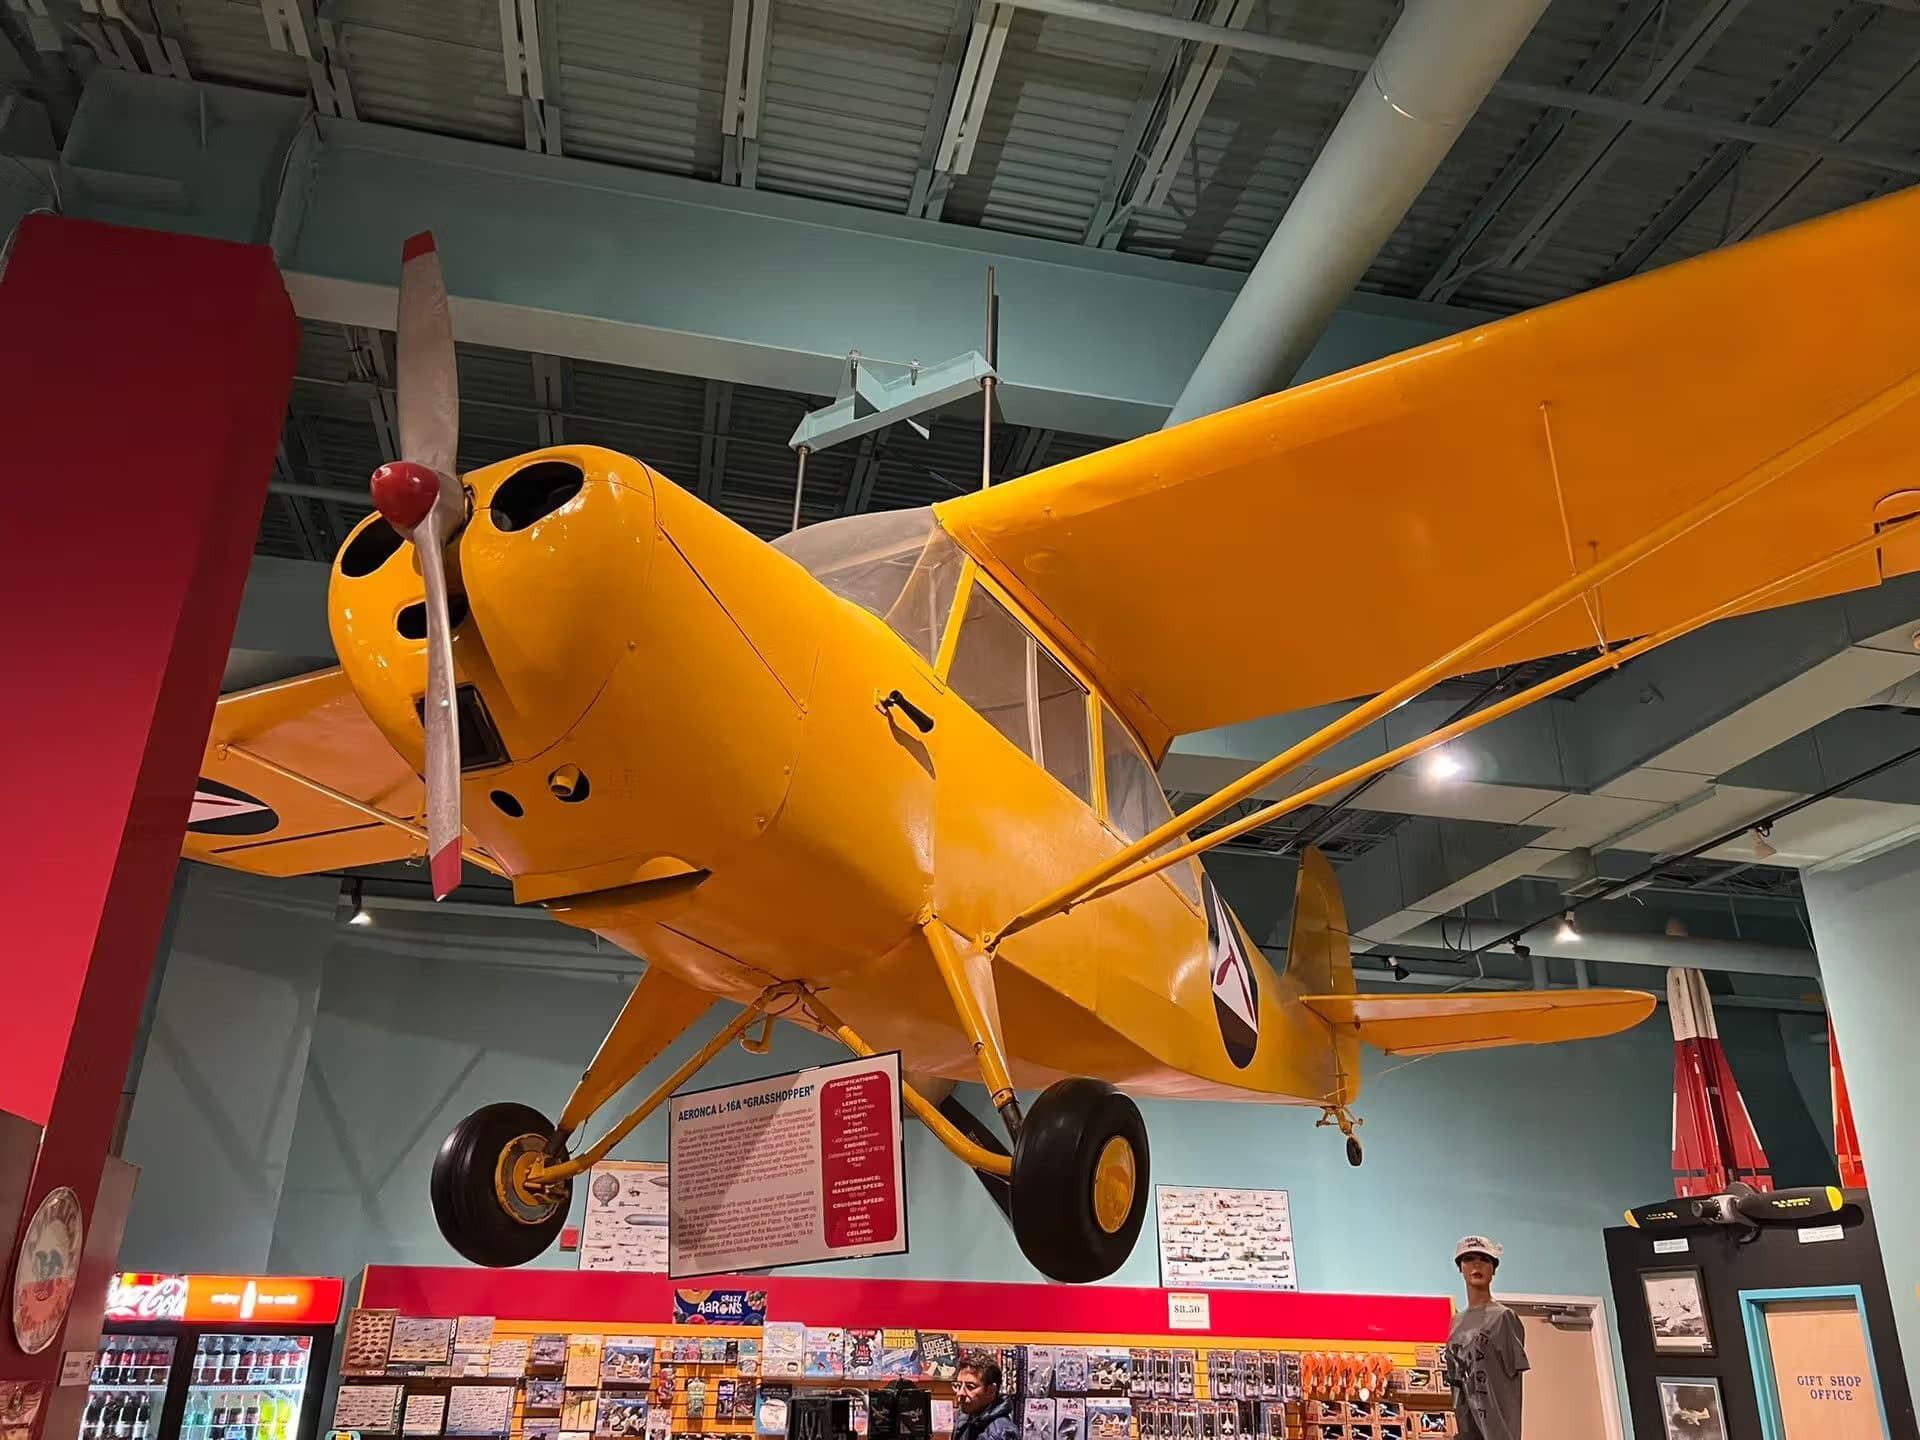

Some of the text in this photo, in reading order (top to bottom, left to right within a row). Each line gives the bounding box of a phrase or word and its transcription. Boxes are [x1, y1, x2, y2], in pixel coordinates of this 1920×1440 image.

[678, 1105, 716, 1122] AERONCA
[718, 1101, 742, 1114] L-16A
[1174, 1304, 1200, 1313] $8.50
[922, 1338, 946, 1350] DOGS
[924, 1346, 954, 1360] SPACE
[1796, 1376, 1862, 1387] GIFT SHOP
[1810, 1389, 1853, 1400] OFFICE
